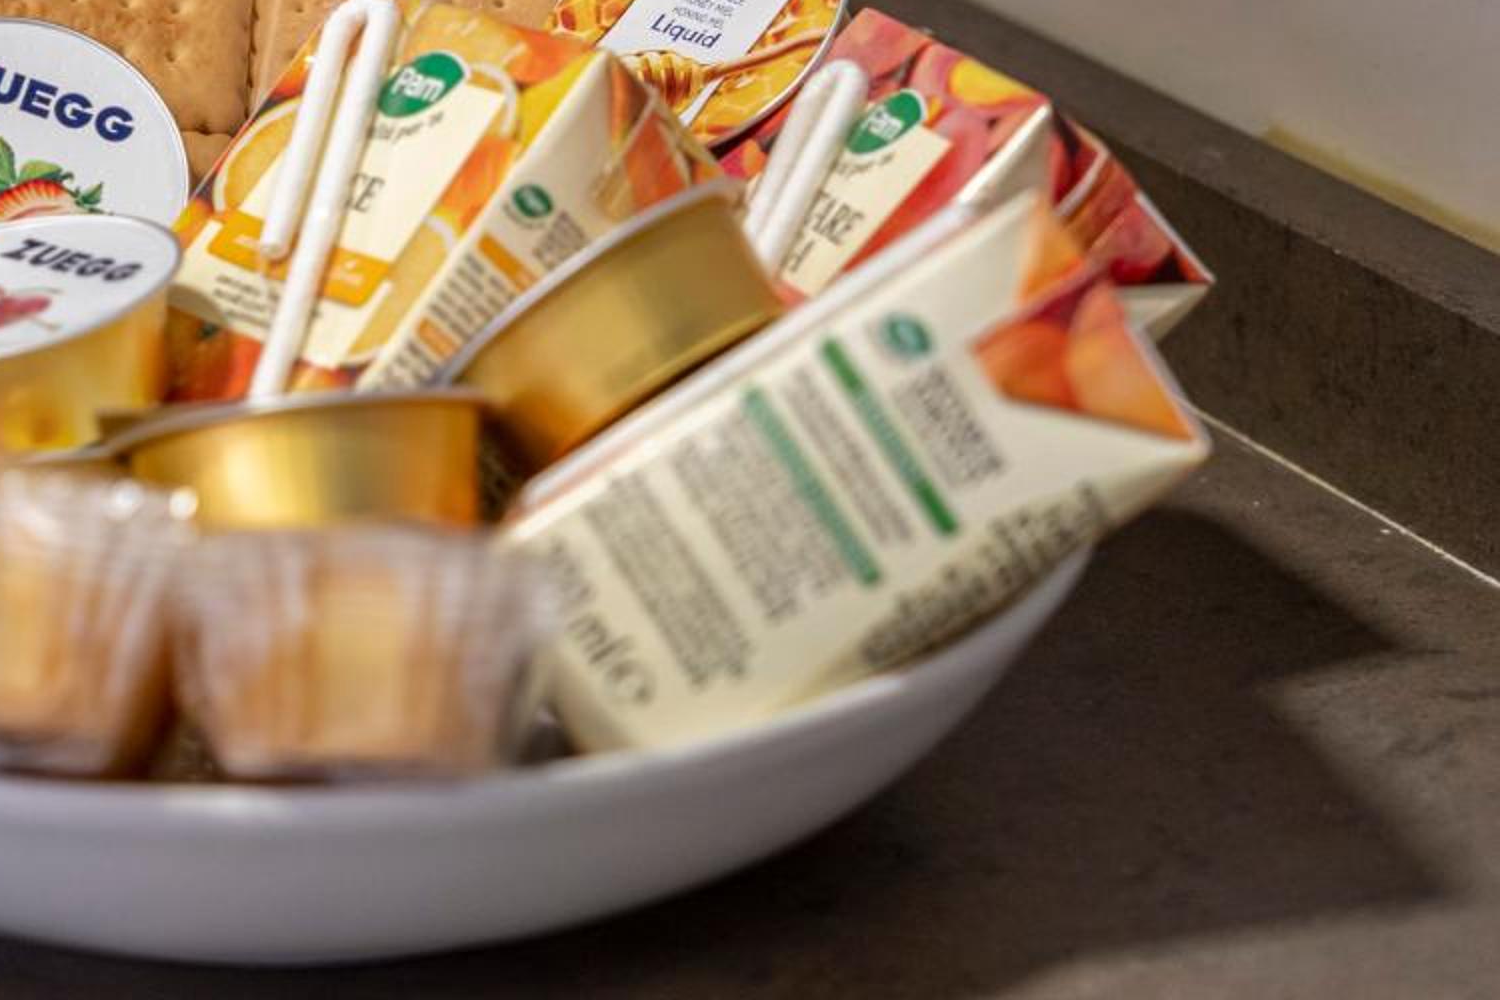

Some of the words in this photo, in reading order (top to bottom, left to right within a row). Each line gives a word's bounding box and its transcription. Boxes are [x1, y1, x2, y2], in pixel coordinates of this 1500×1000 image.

[650, 13, 721, 49] Liquid
[391, 66, 446, 101] Pam
[0, 237, 143, 283] ZUEGG
